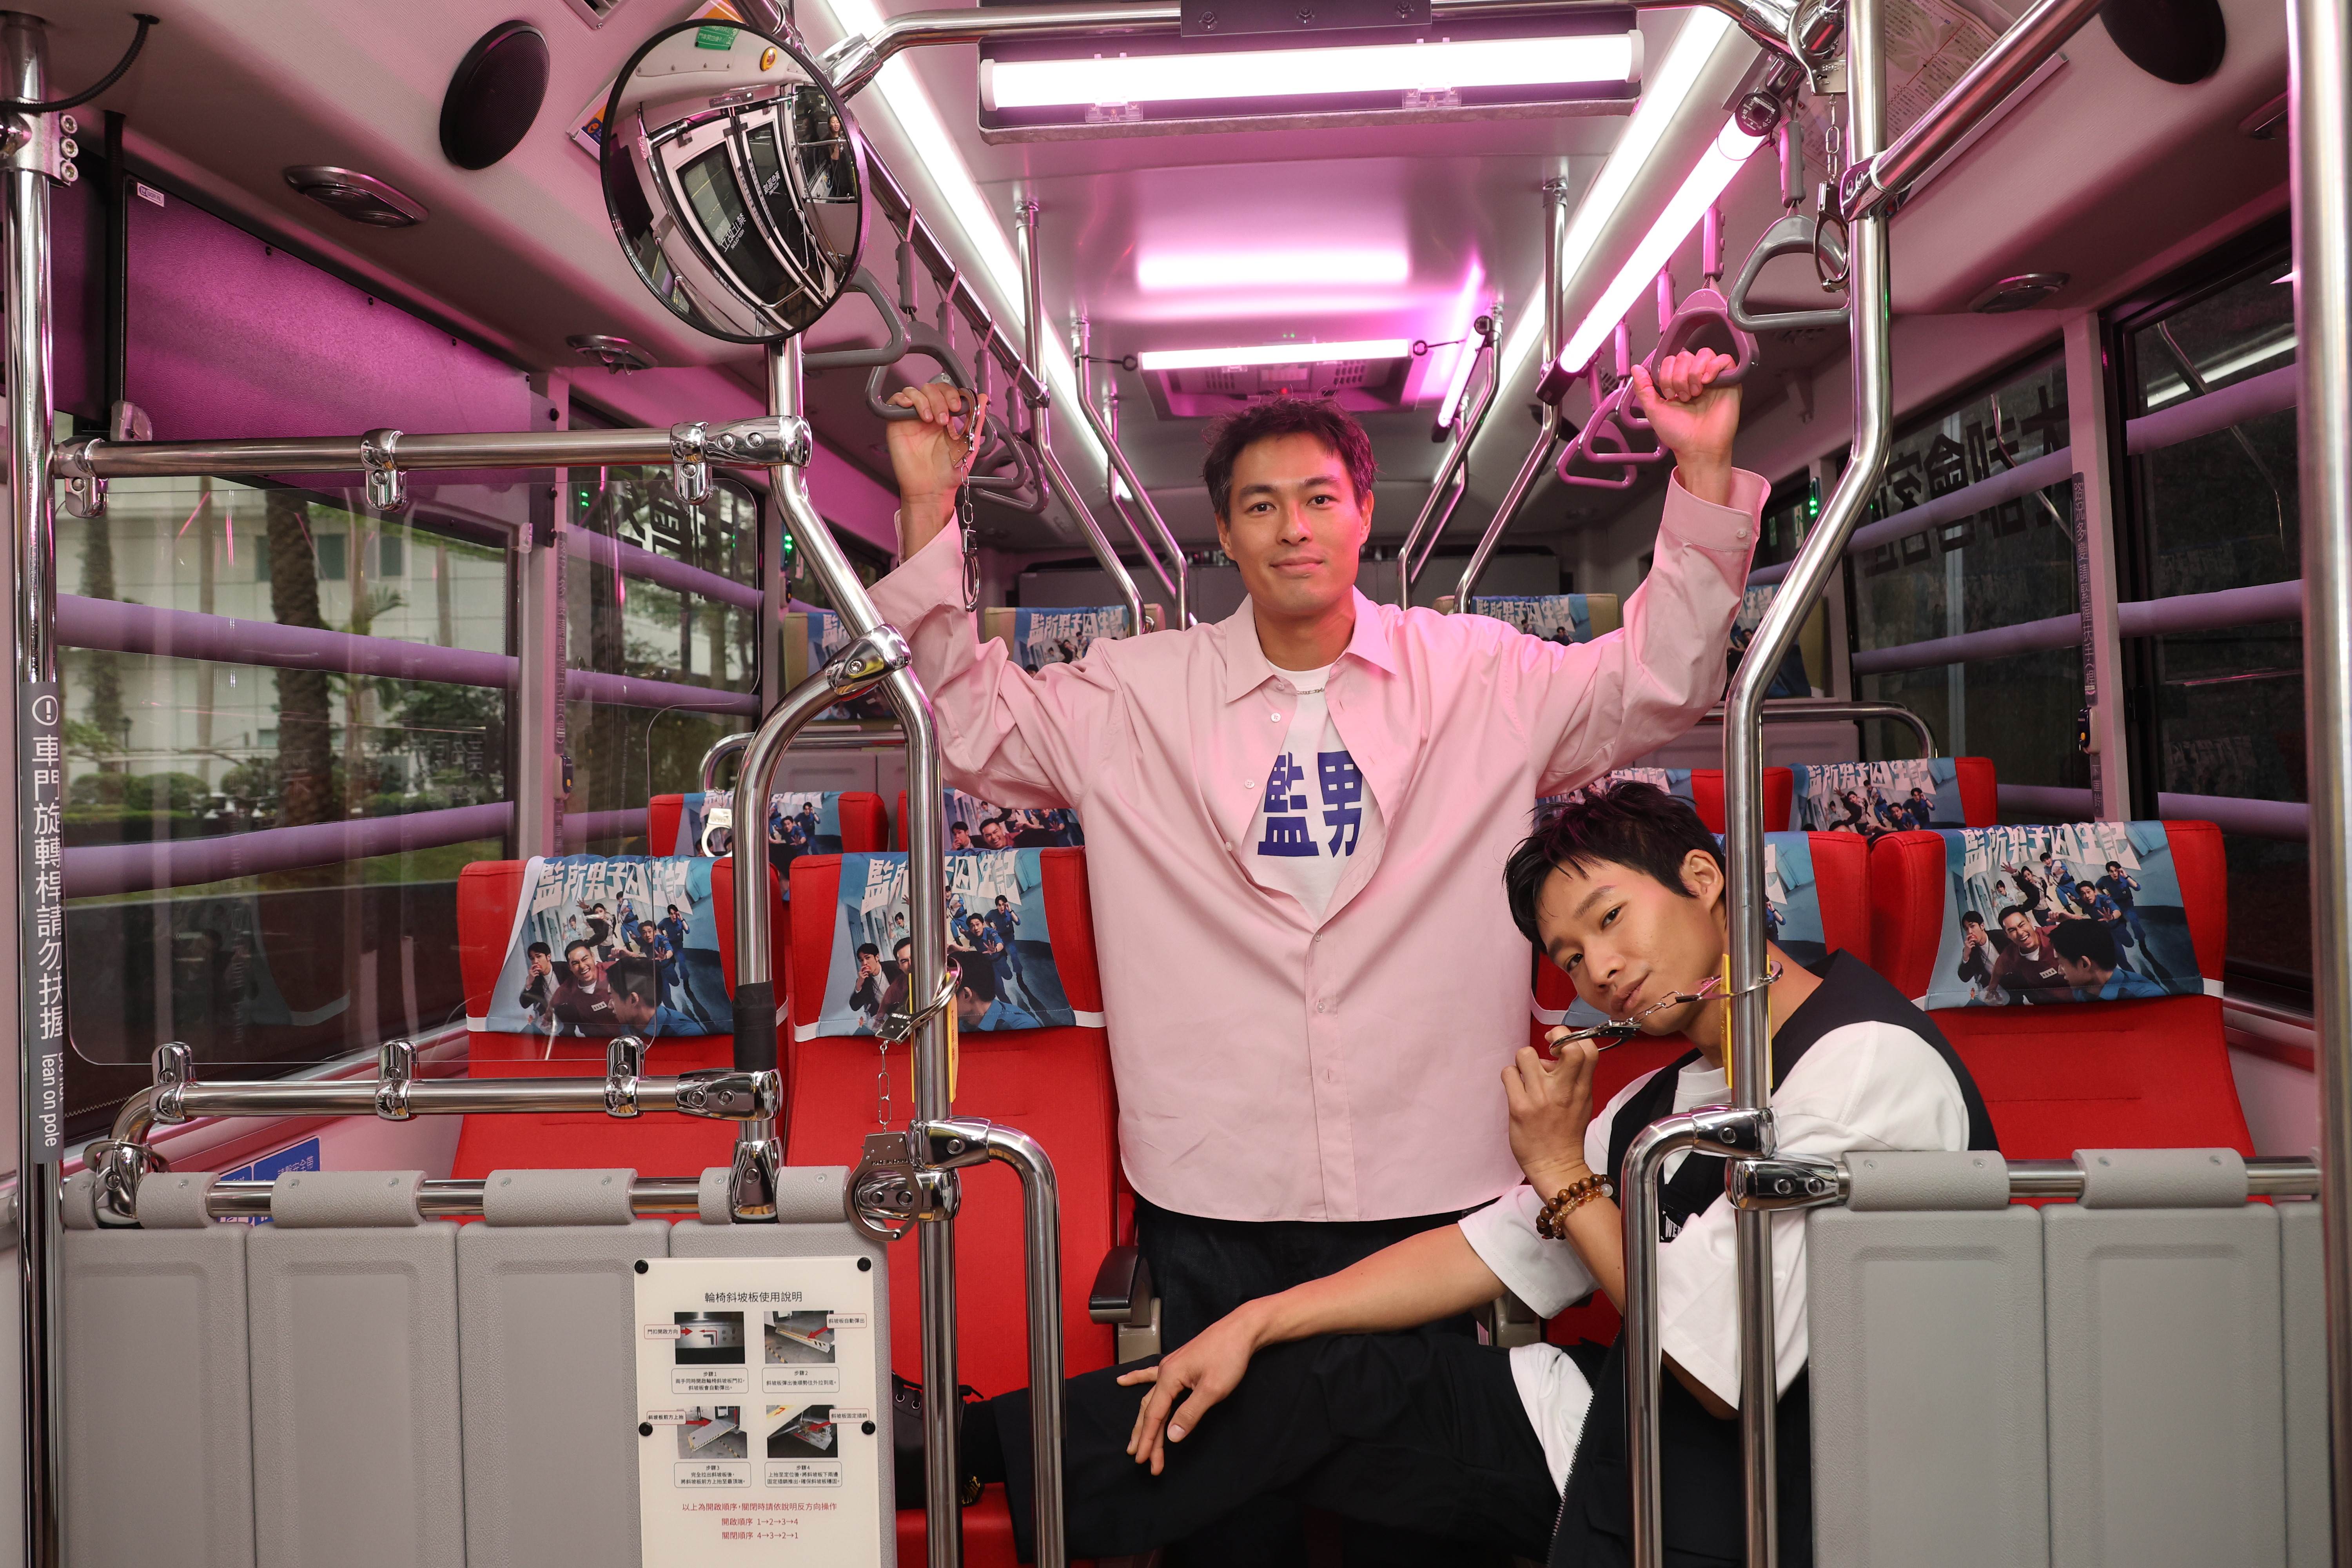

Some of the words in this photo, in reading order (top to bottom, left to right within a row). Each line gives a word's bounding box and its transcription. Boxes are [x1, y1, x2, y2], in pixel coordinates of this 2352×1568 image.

[1257, 750, 1363, 858] 監男
[1958, 821, 2141, 883] 監所男子囚生記
[32, 734, 63, 1040] 車門旋轉桿請勿扶握
[532, 860, 693, 916] 監所男子囚生記
[860, 849, 1022, 916] 監所囚生記
[42, 1054, 58, 1086] lean
[43, 1089, 56, 1110] on
[39, 1113, 60, 1147] pole
[704, 1291, 802, 1303] 輪椅斜坡板使用說明
[721, 1517, 753, 1526] 開啟順序
[722, 1531, 753, 1540] 關閉順序
